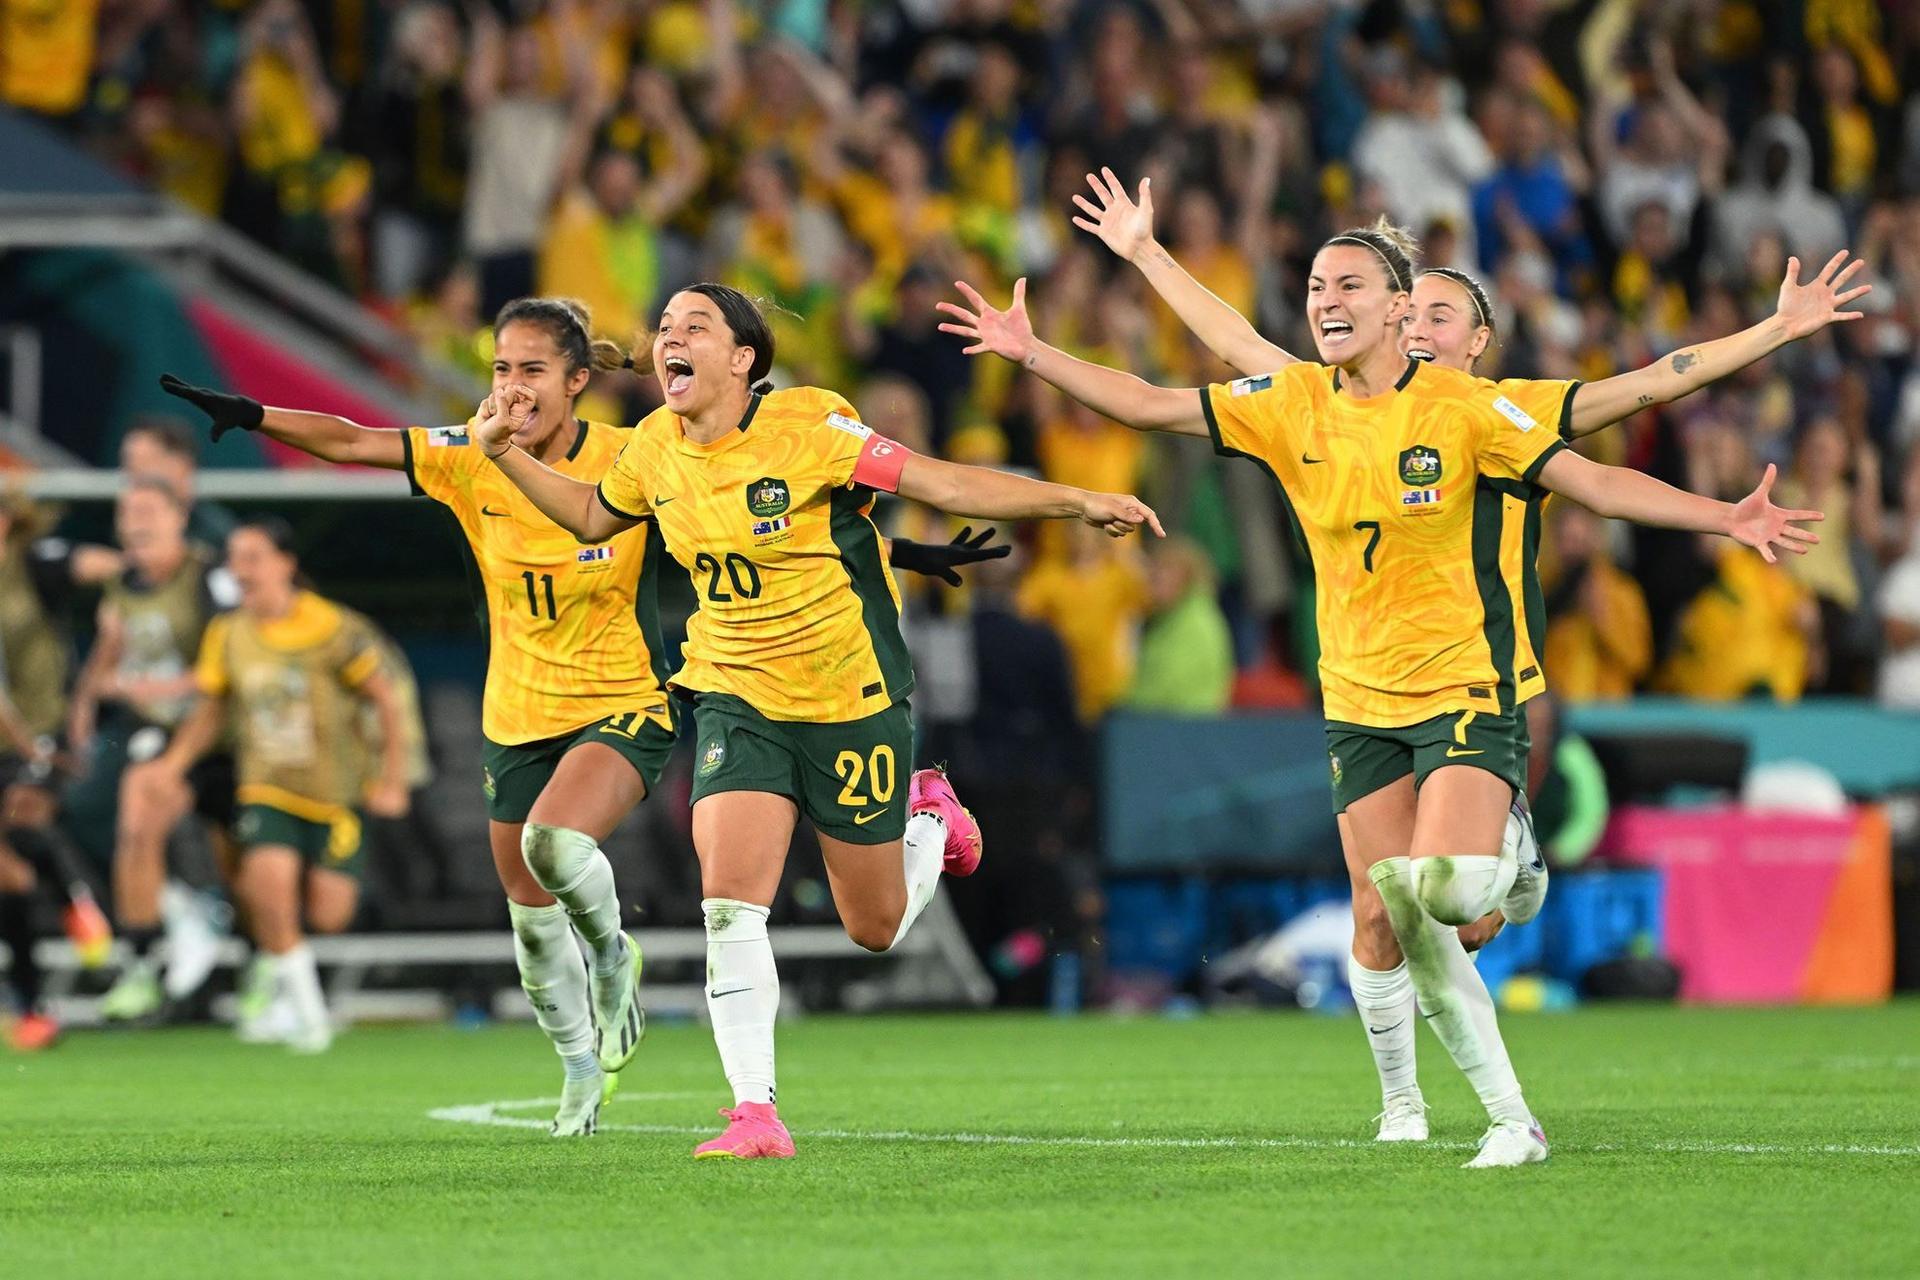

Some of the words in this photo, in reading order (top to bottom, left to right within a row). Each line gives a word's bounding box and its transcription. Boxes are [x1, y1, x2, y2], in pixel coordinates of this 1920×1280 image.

[1353, 520, 1381, 574] 7
[521, 570, 557, 621] 11
[695, 552, 762, 602] 20
[1446, 710, 1477, 746] 7
[834, 744, 896, 806] 20
